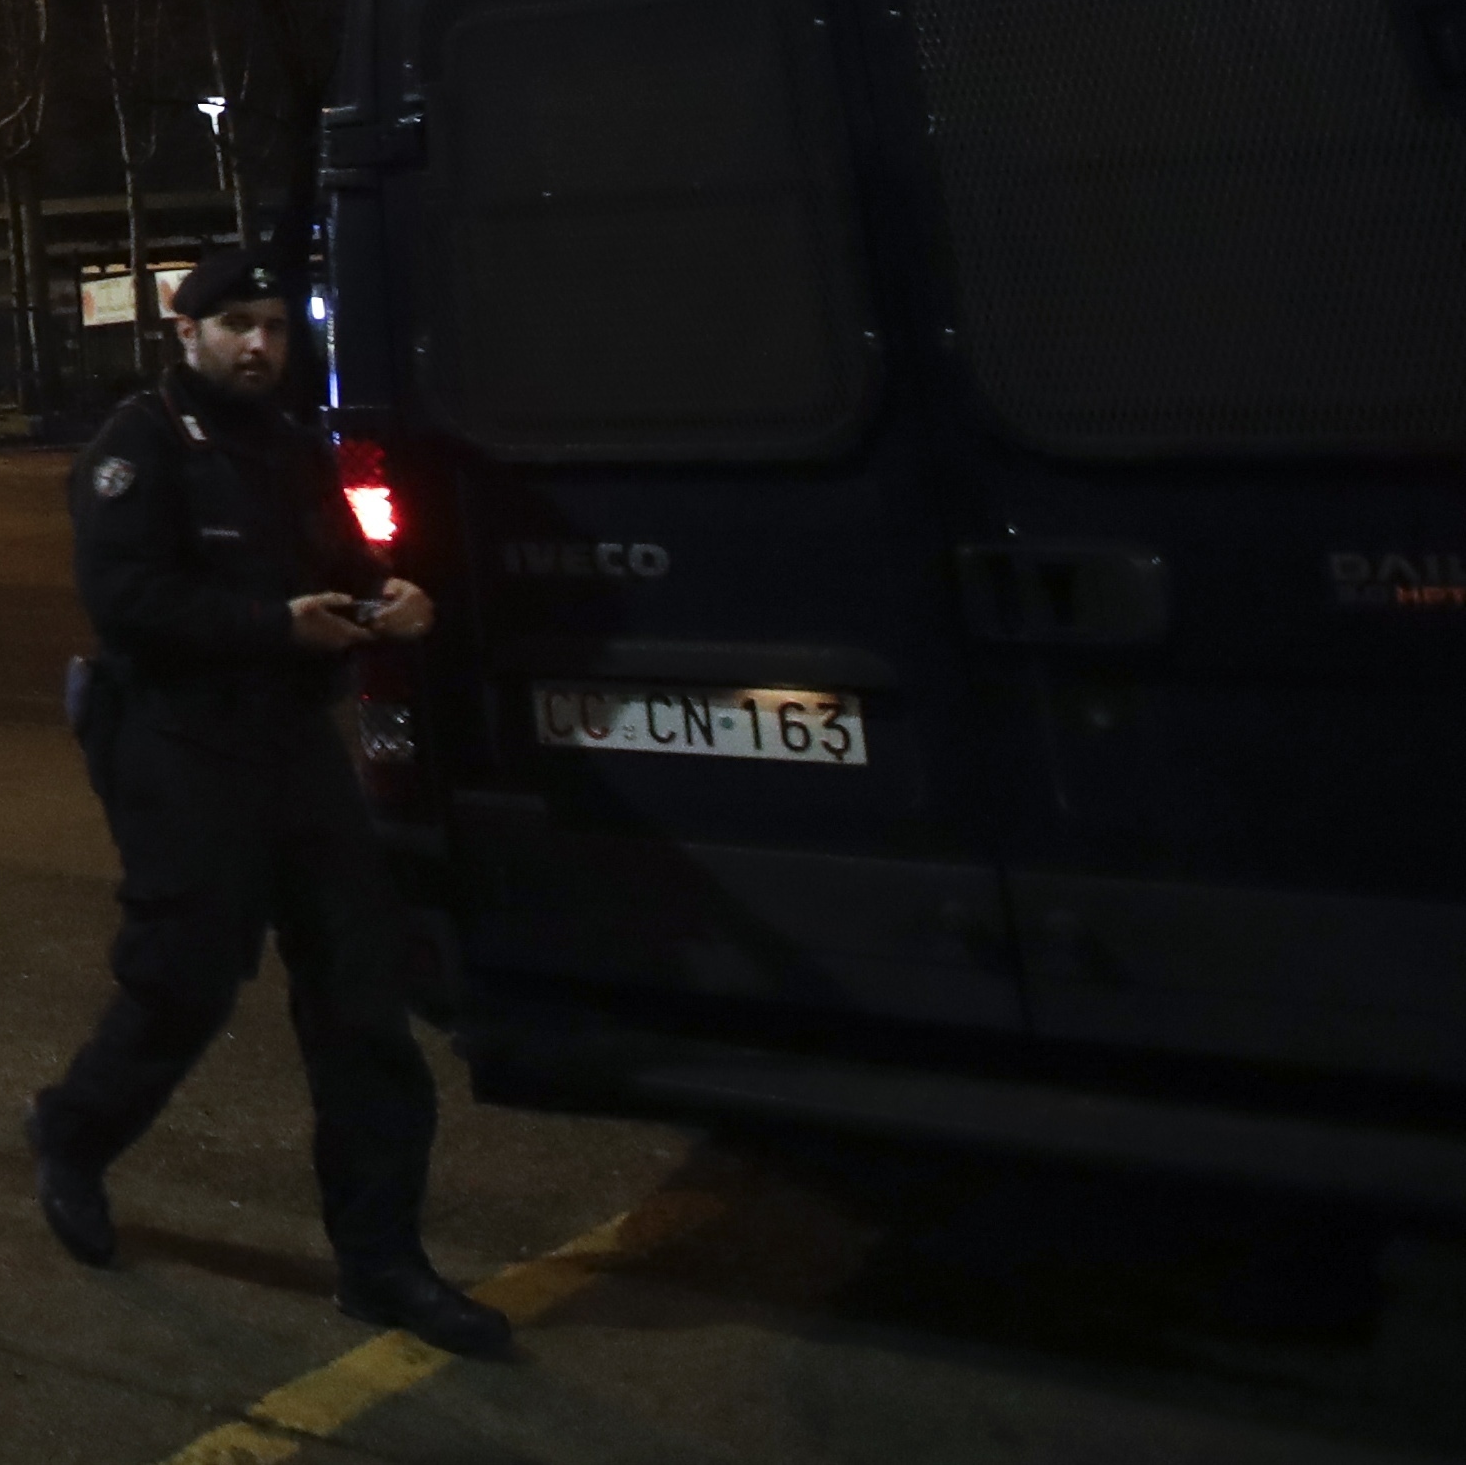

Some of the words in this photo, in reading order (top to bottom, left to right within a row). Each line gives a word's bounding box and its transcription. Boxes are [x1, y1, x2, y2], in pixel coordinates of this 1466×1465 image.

[504, 542, 670, 576] IVECO
[544, 688, 610, 740] CC
[647, 692, 715, 747] CN
[744, 697, 851, 759] 163
